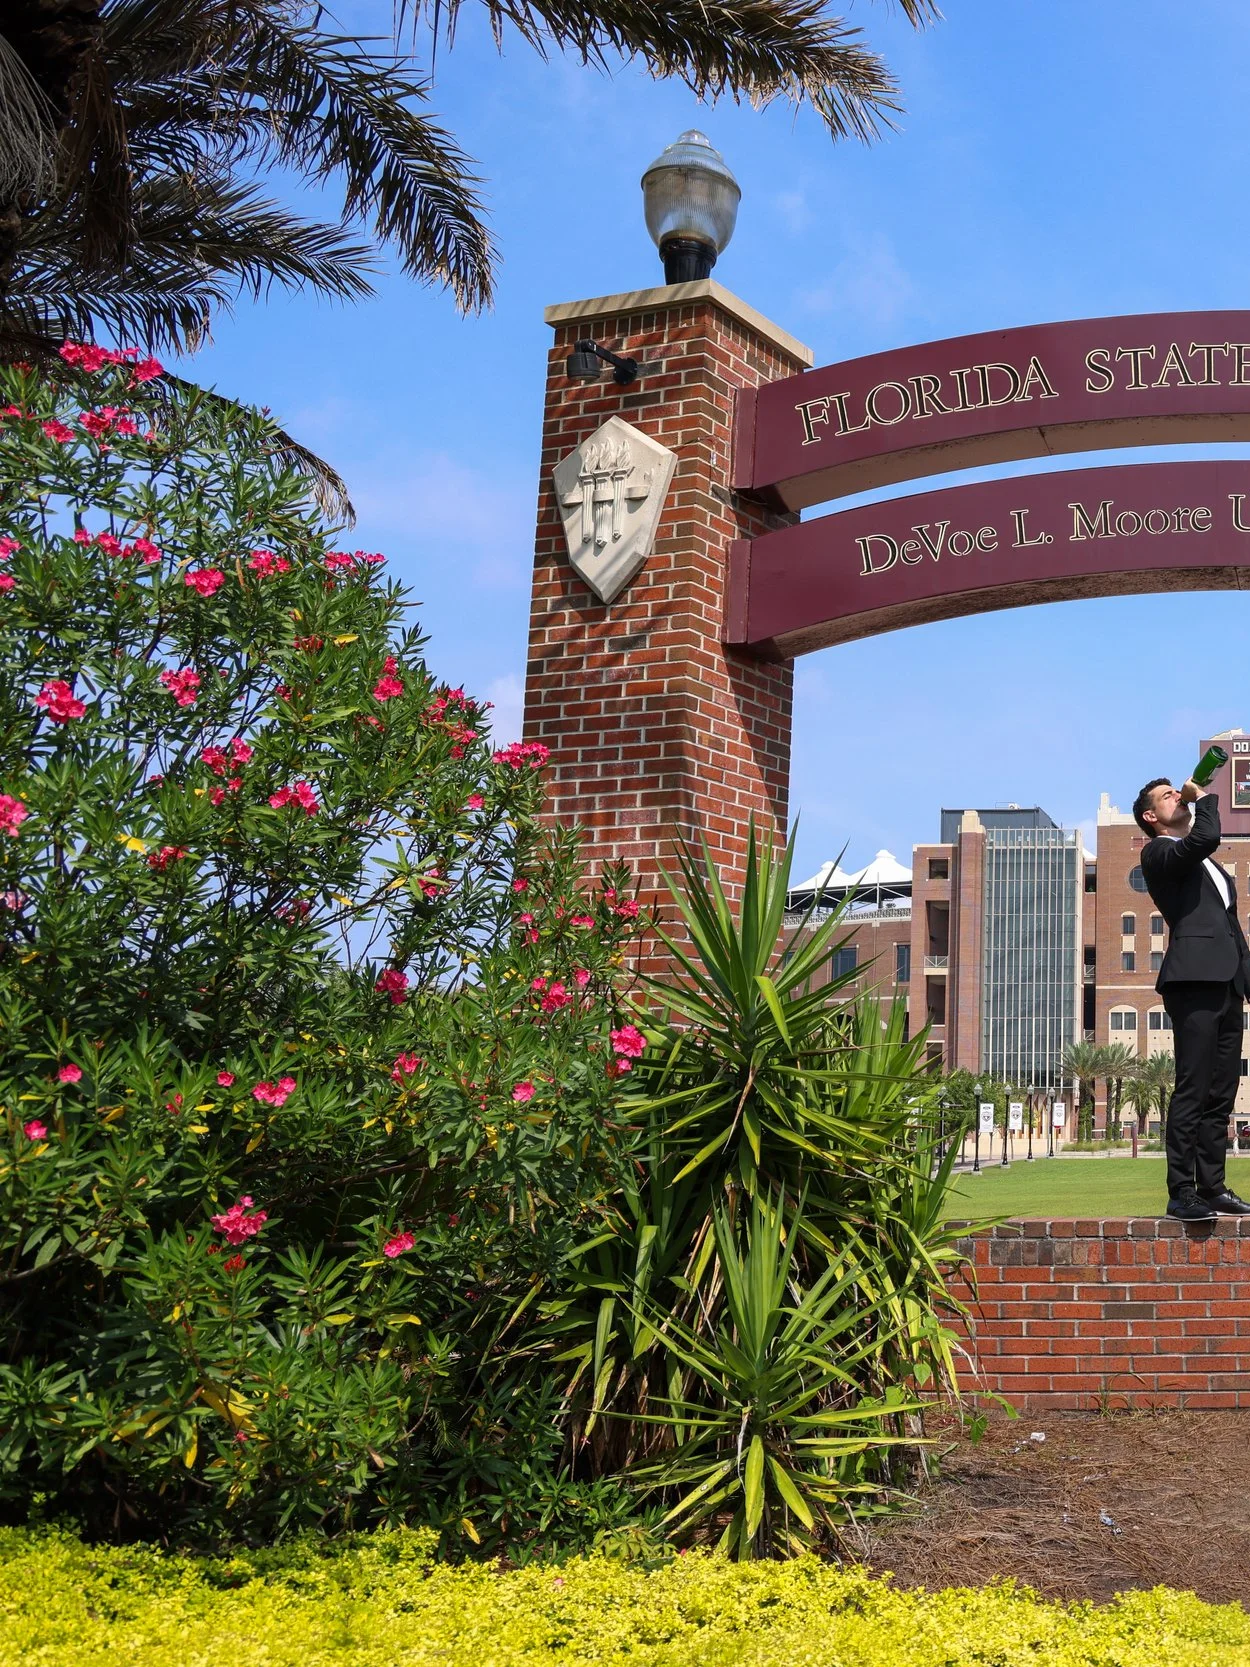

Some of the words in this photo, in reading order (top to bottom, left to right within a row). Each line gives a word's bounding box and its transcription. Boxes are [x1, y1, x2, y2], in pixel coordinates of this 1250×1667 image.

[795, 356, 1059, 446] FLORIDA
[855, 520, 998, 576] DeVoe
[1010, 508, 1054, 548] L.
[1068, 499, 1212, 541] Moore
